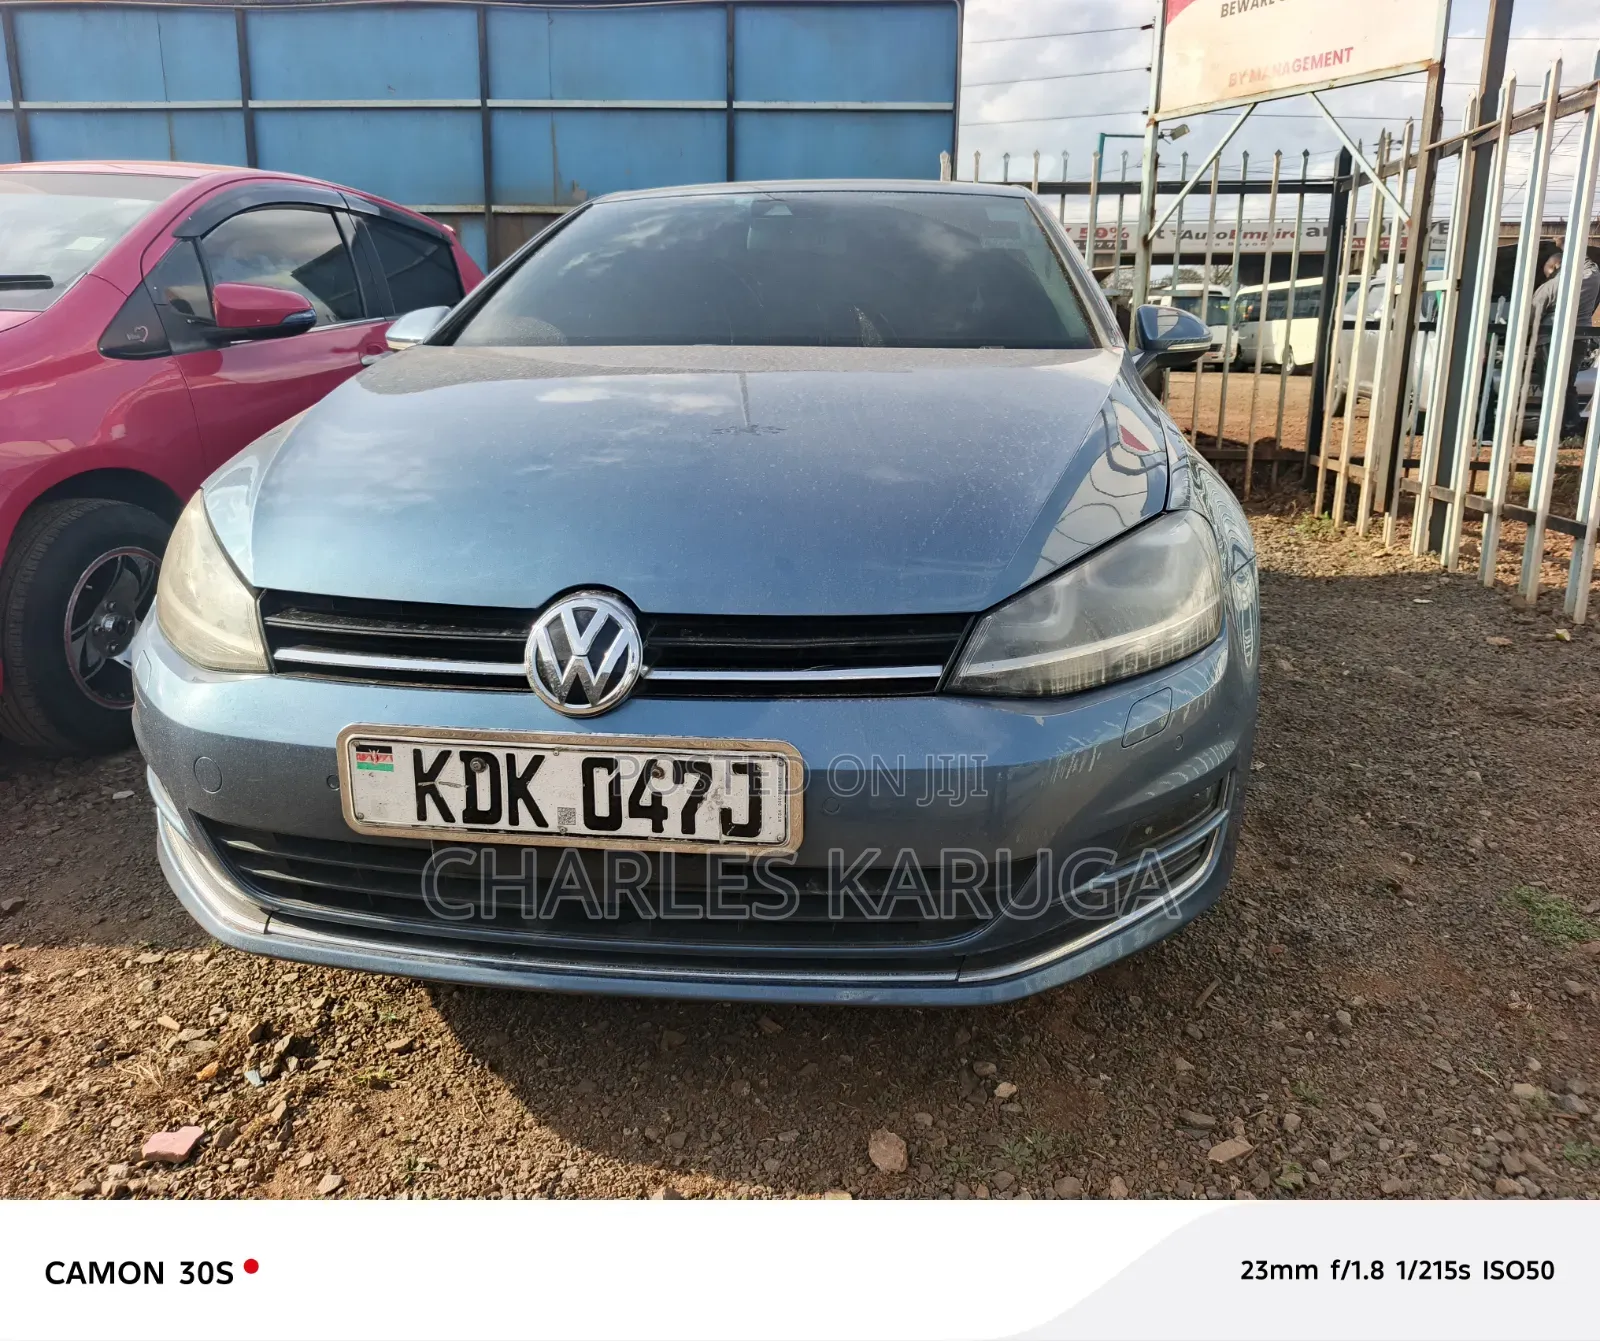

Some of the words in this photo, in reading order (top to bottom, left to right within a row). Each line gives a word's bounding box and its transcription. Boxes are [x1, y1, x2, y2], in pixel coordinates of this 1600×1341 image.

[1228, 69, 1247, 87] BY
[1248, 47, 1354, 84] MANAGEMENT
[1180, 227, 1302, 242] AuoEmpire
[413, 748, 549, 828] KDK
[581, 757, 763, 838] 047J
